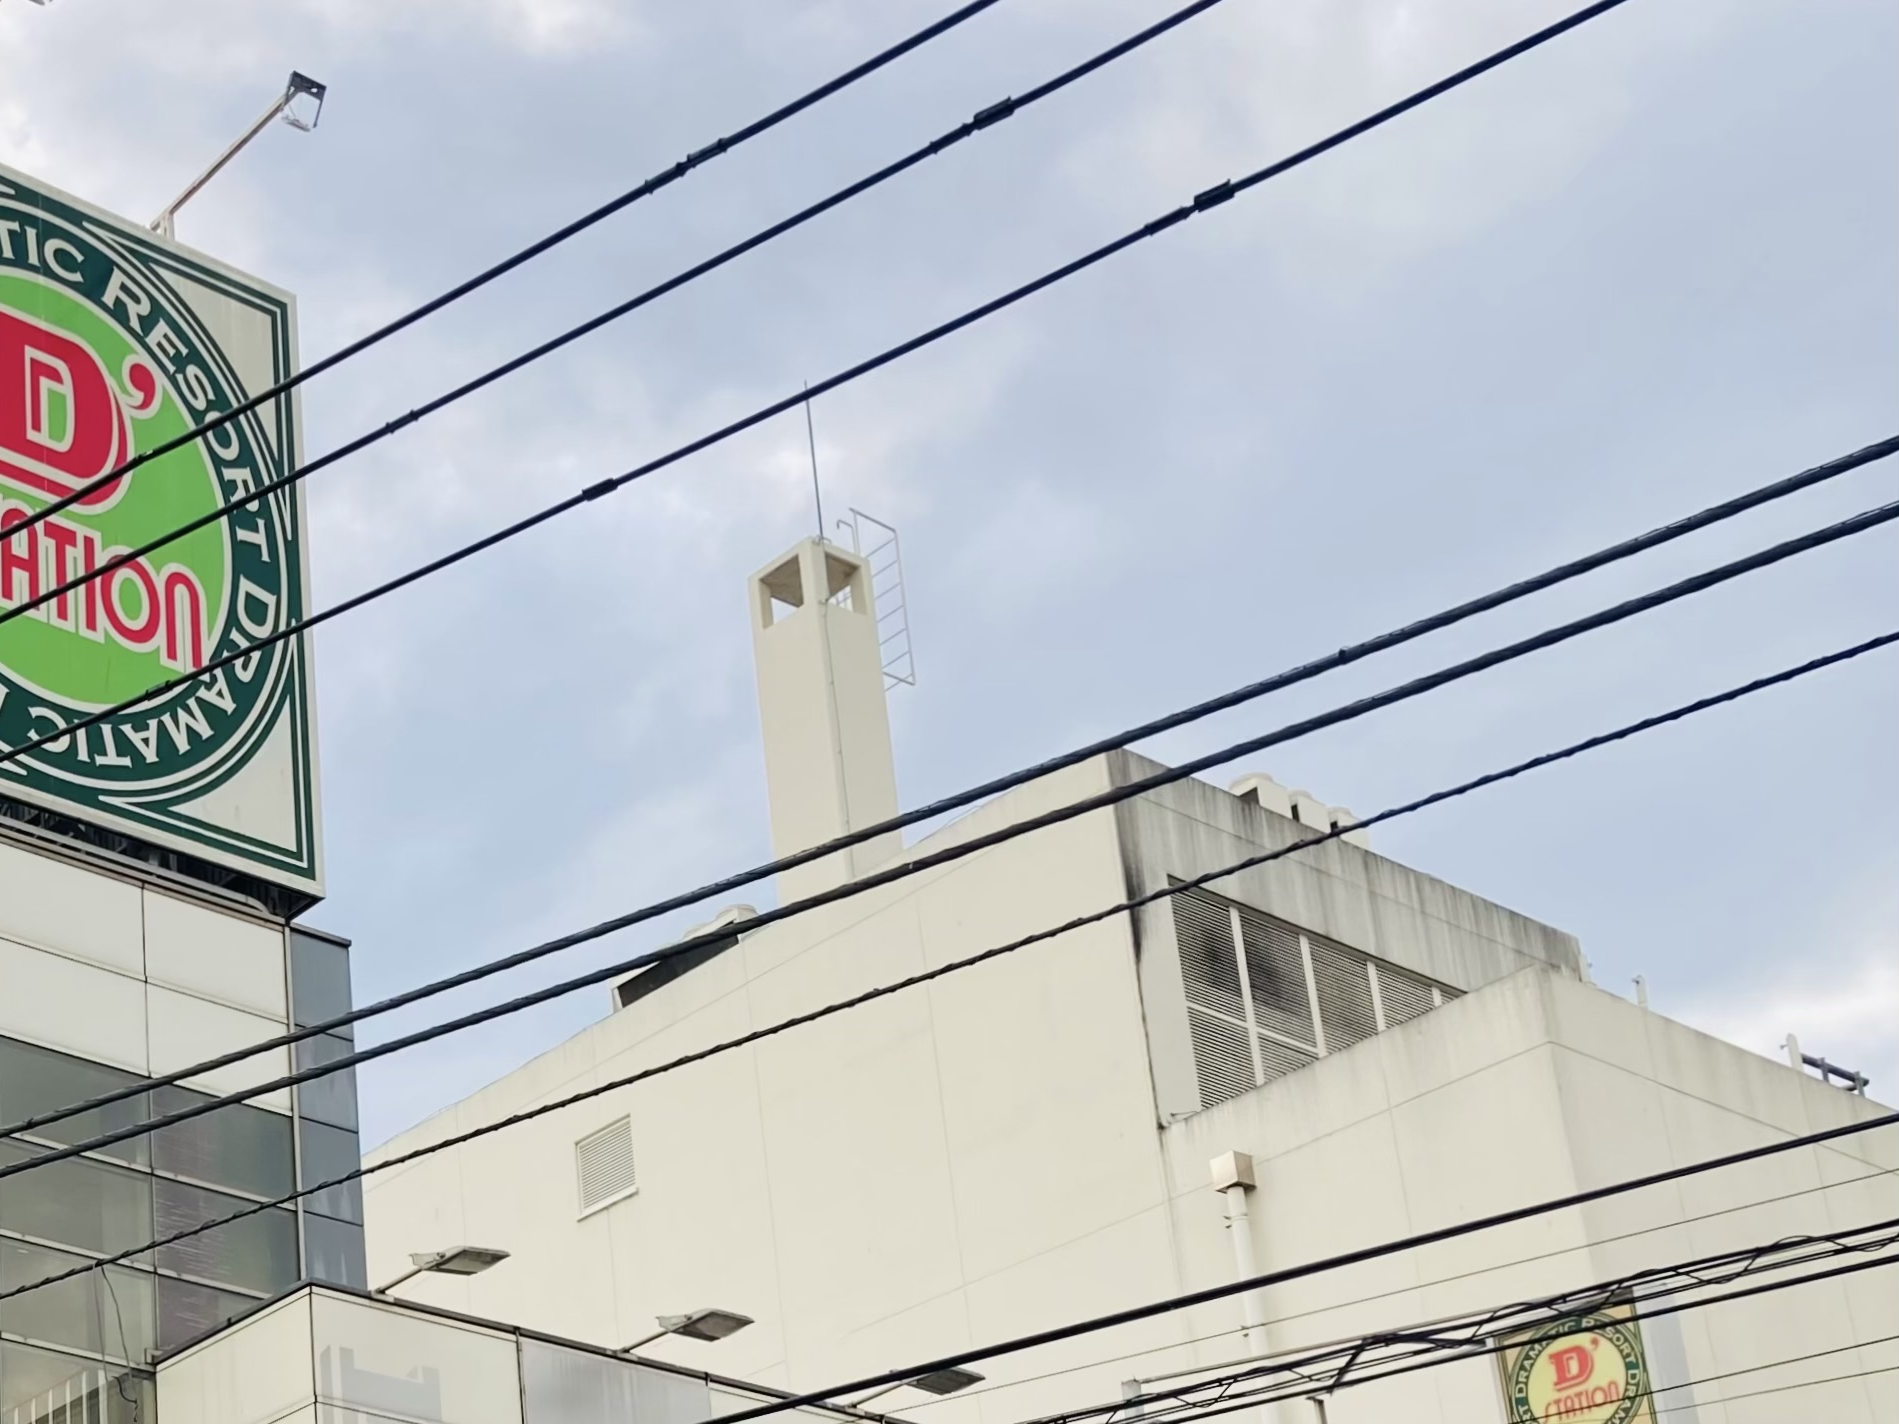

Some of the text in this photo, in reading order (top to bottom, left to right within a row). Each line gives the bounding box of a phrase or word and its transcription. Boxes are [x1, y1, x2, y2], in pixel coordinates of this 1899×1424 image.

[101, 266, 271, 562] RESORT
[27, 574, 277, 768] DRAMATIC
[1581, 1318, 1638, 1364] RSORT
